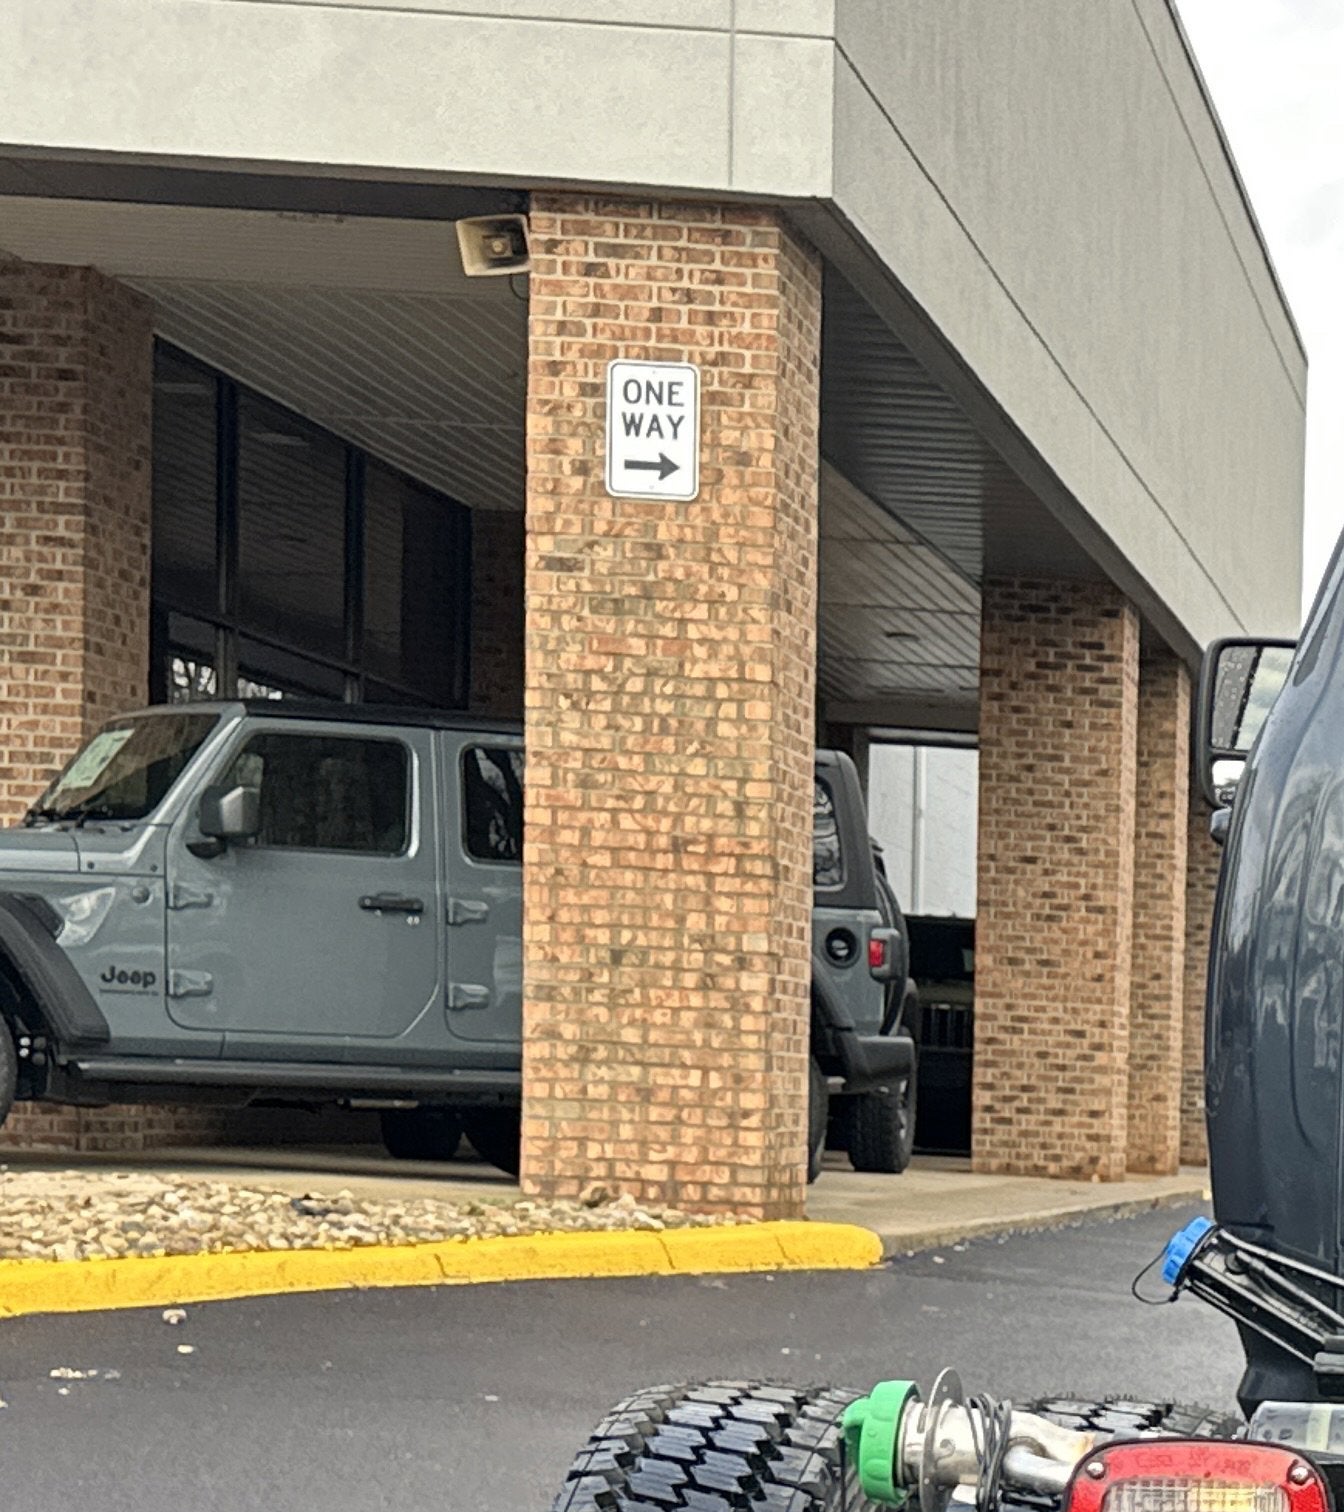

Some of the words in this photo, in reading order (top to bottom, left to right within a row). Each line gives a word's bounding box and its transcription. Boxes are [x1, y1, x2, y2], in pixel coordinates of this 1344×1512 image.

[622, 378, 685, 407] ONE
[621, 411, 685, 440] WAY
[101, 965, 156, 988] Jeep
